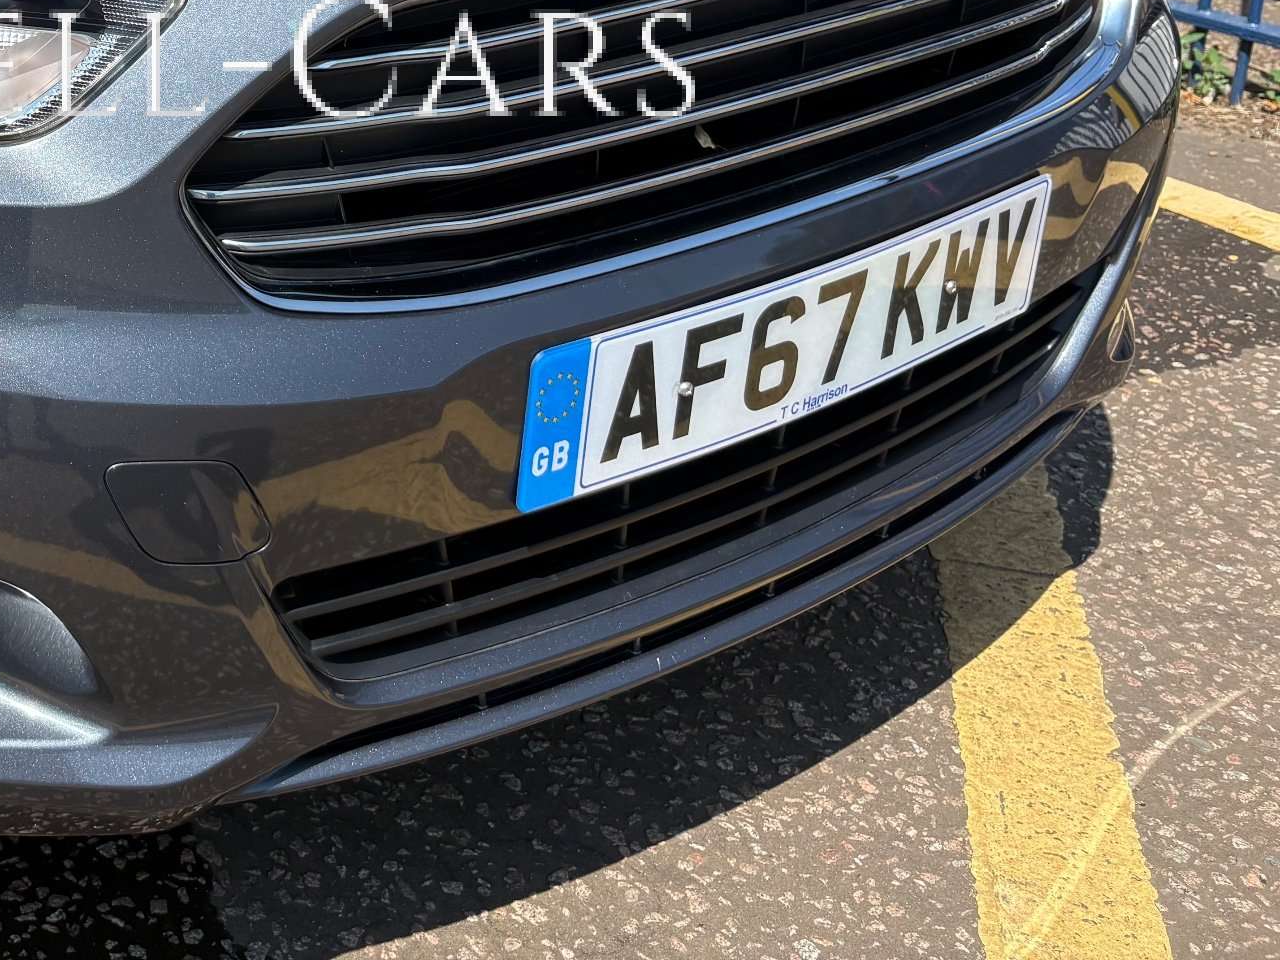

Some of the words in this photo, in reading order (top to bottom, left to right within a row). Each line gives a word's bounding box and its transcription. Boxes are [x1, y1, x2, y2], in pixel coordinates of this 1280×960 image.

[600, 268, 869, 465] AF67
[880, 197, 1037, 360] KWV
[780, 405, 789, 419] T
[791, 401, 800, 415] C
[802, 383, 848, 411] Harrison
[531, 439, 570, 477] GB
